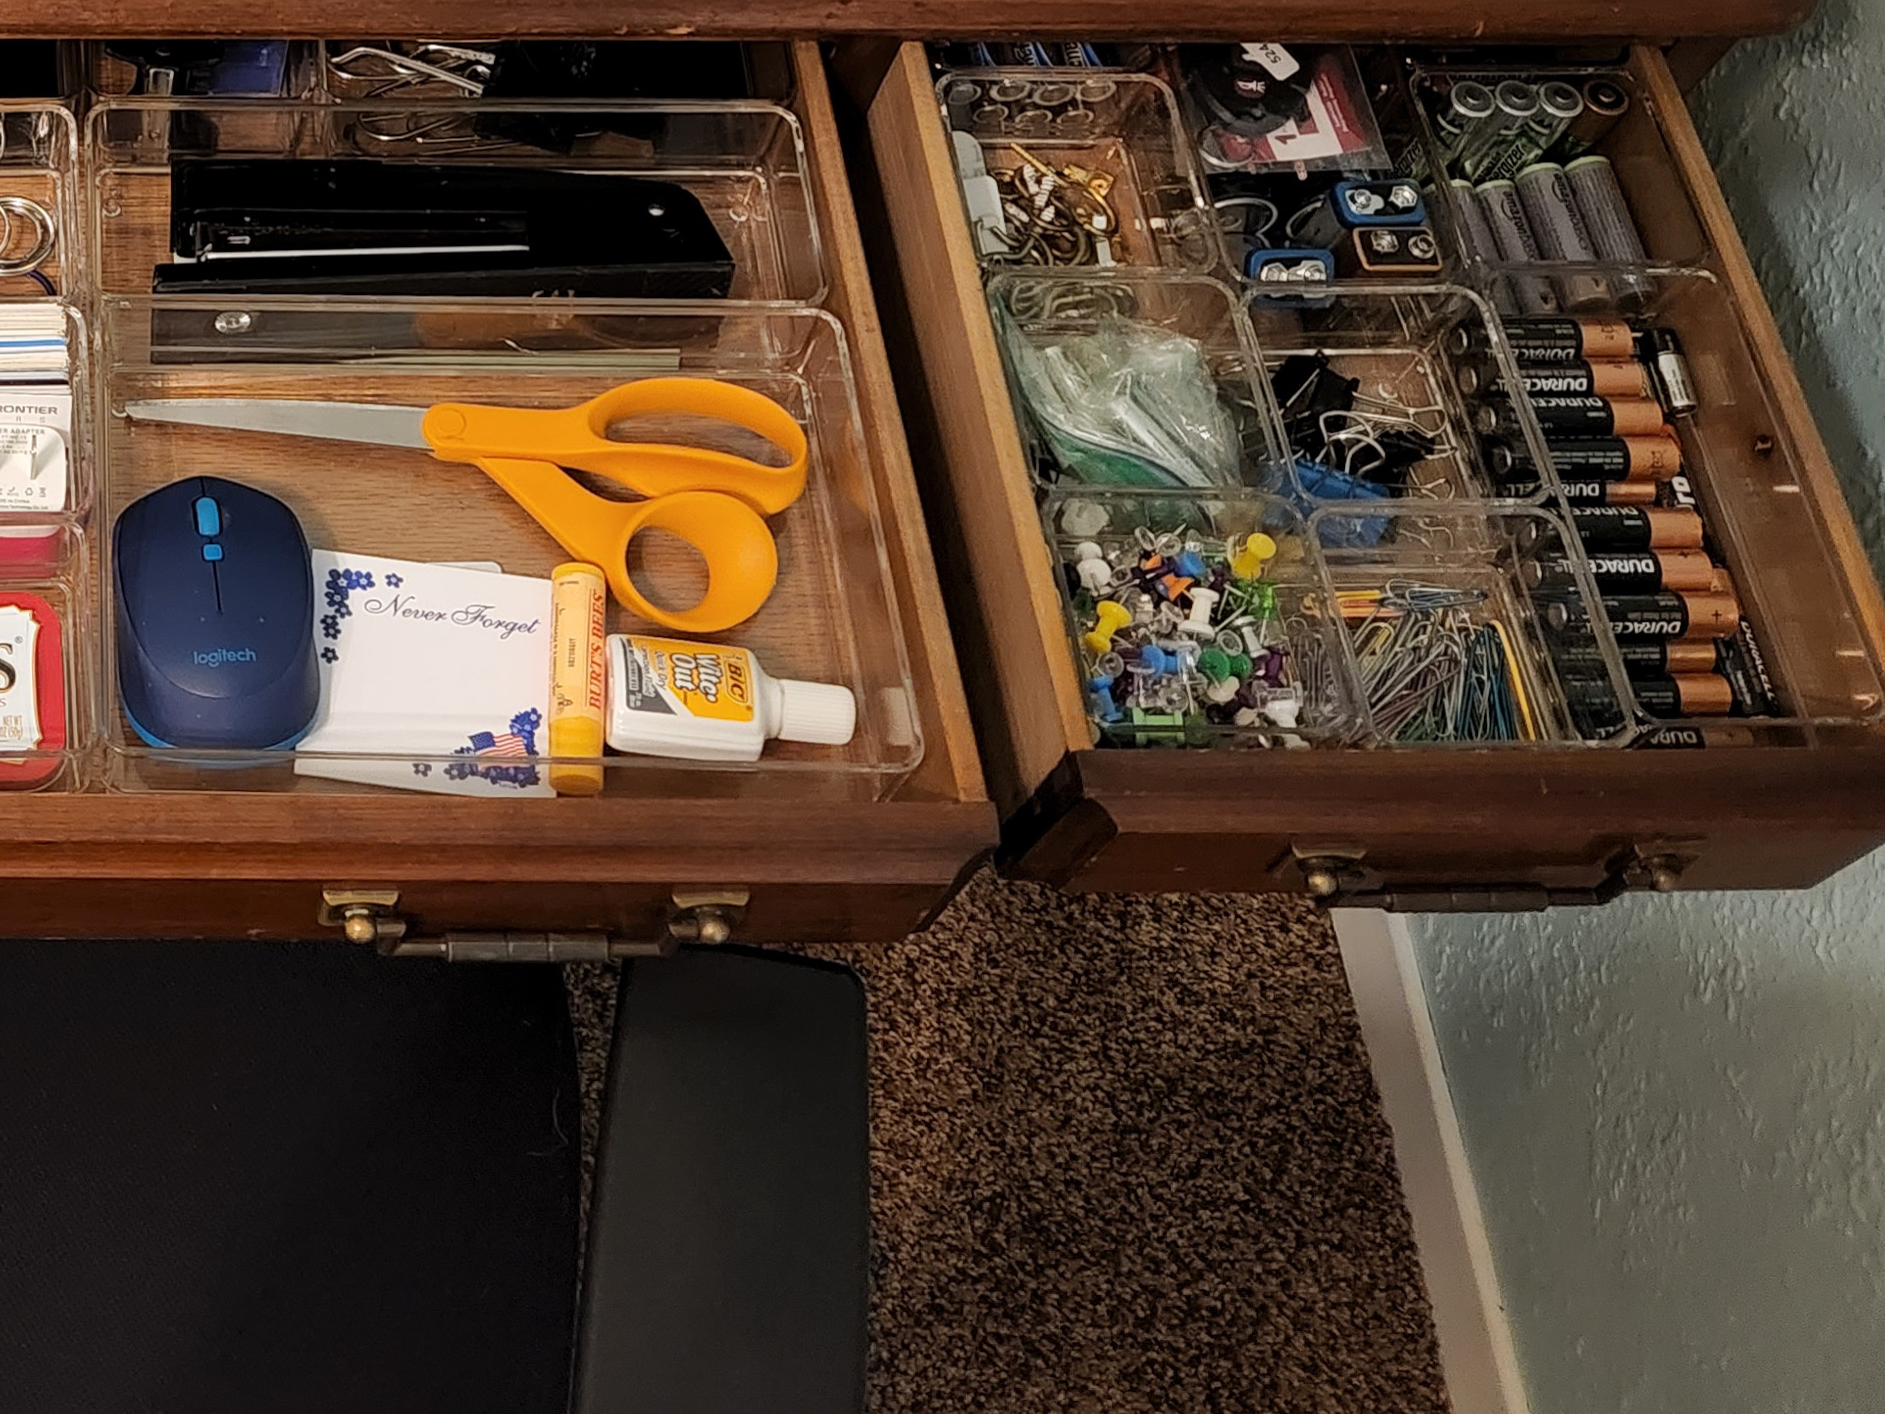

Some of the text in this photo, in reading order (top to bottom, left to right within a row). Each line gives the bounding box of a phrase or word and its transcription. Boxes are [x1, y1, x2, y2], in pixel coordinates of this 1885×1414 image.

[1484, 347, 1575, 361] DURACEL
[1495, 376, 1588, 392] DURACEL
[1556, 559, 1655, 573] DURACEL
[364, 593, 542, 640] Never Forget
[1586, 620, 1682, 635] DURACEL
[193, 648, 257, 667] logitech
[588, 588, 605, 711] BURT'S BEES
[670, 652, 698, 692] Out
[727, 663, 746, 703] BIC
